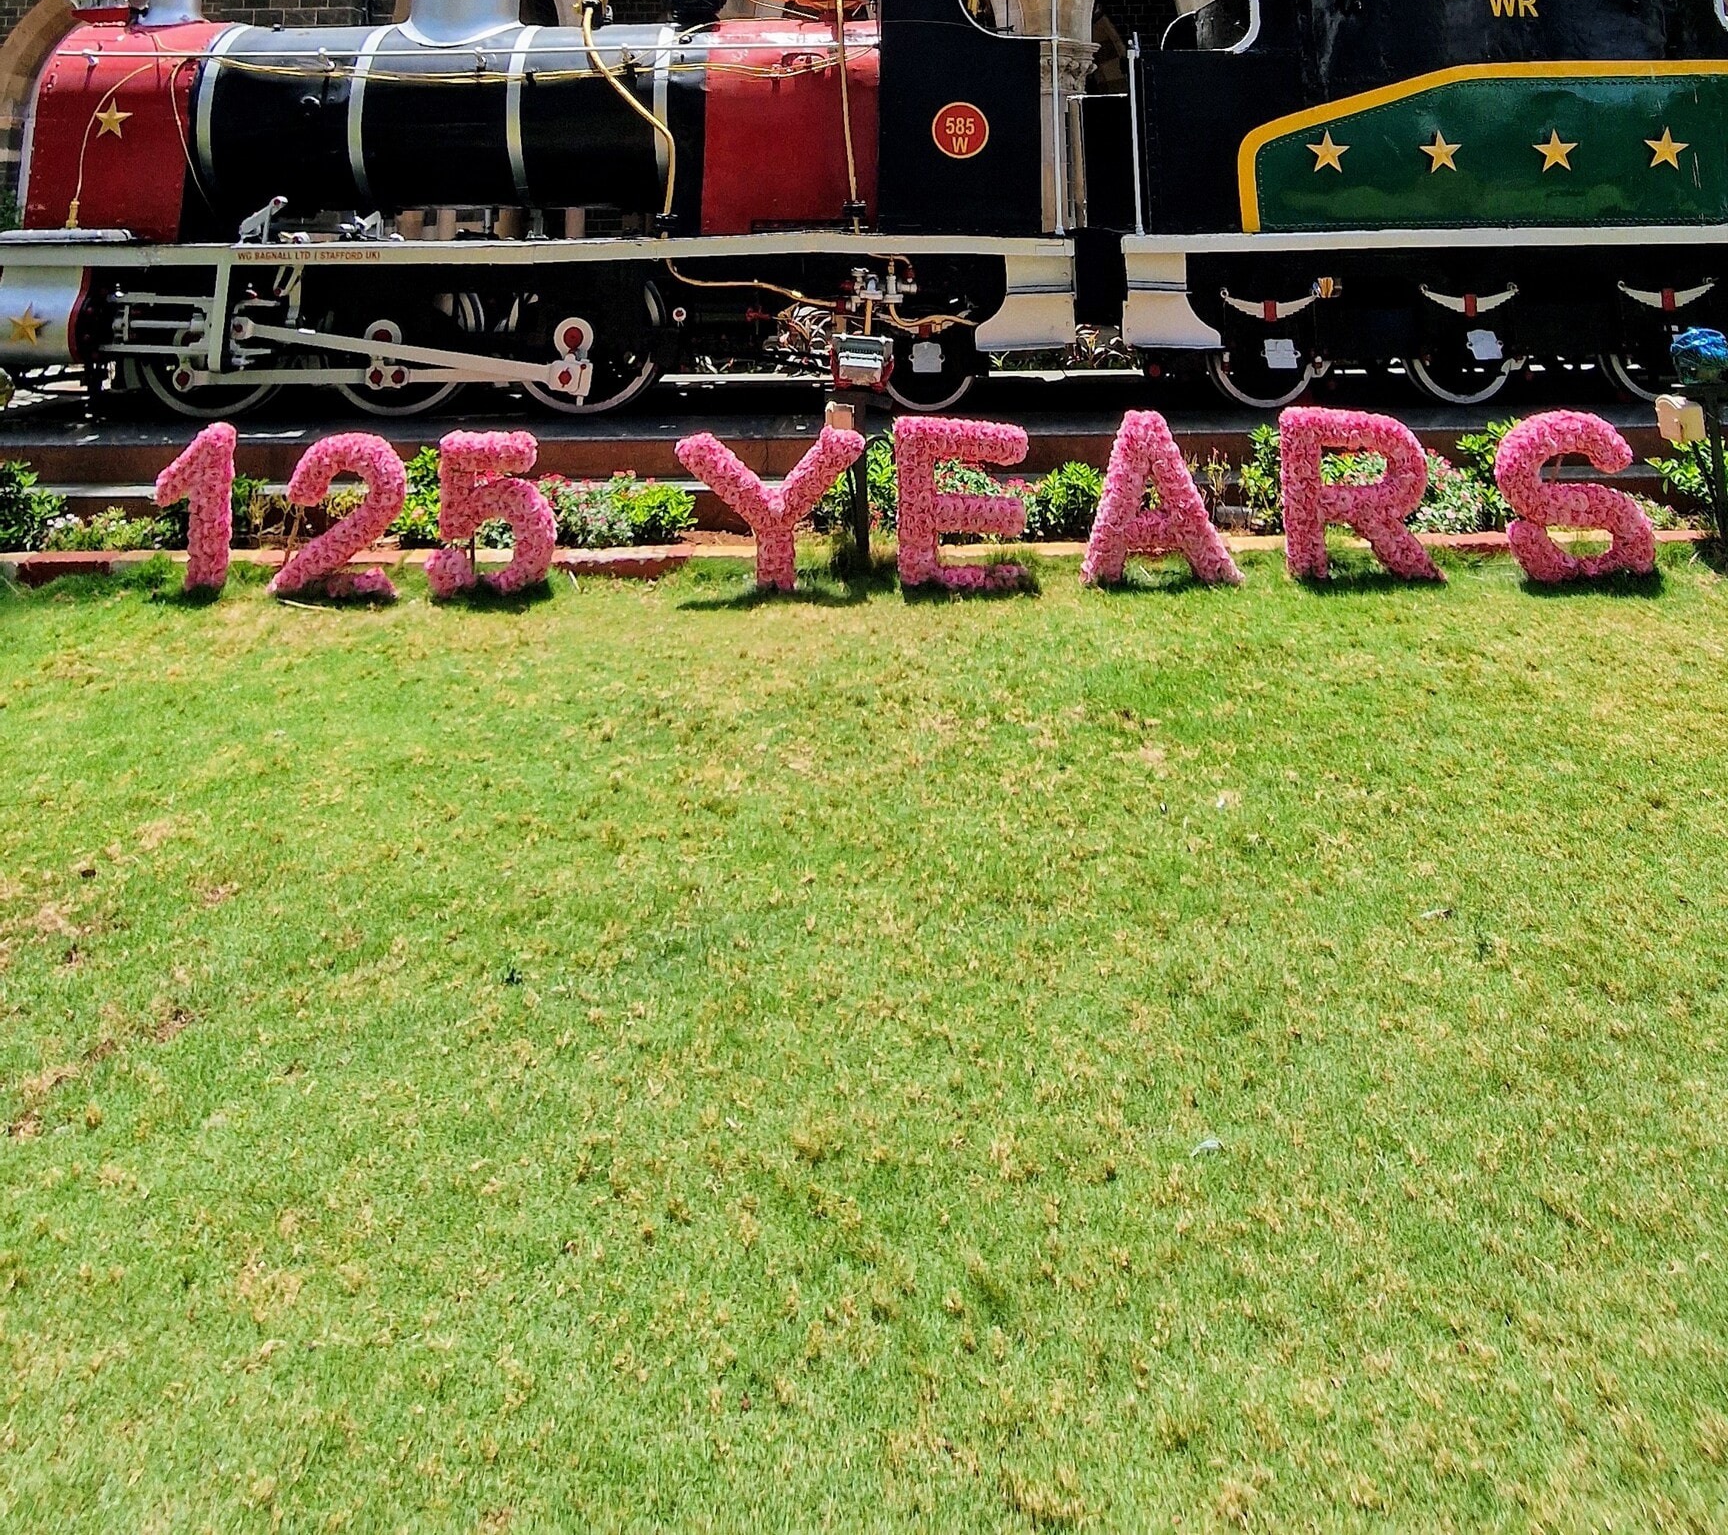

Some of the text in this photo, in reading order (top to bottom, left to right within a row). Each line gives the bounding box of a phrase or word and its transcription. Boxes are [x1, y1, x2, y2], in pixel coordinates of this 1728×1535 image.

[945, 117, 975, 135] 585
[952, 136, 969, 153] W
[237, 252, 252, 261] WG
[254, 251, 292, 261] BAGNALL
[295, 251, 311, 260] LTD
[154, 407, 1657, 597] 125 YEARS
